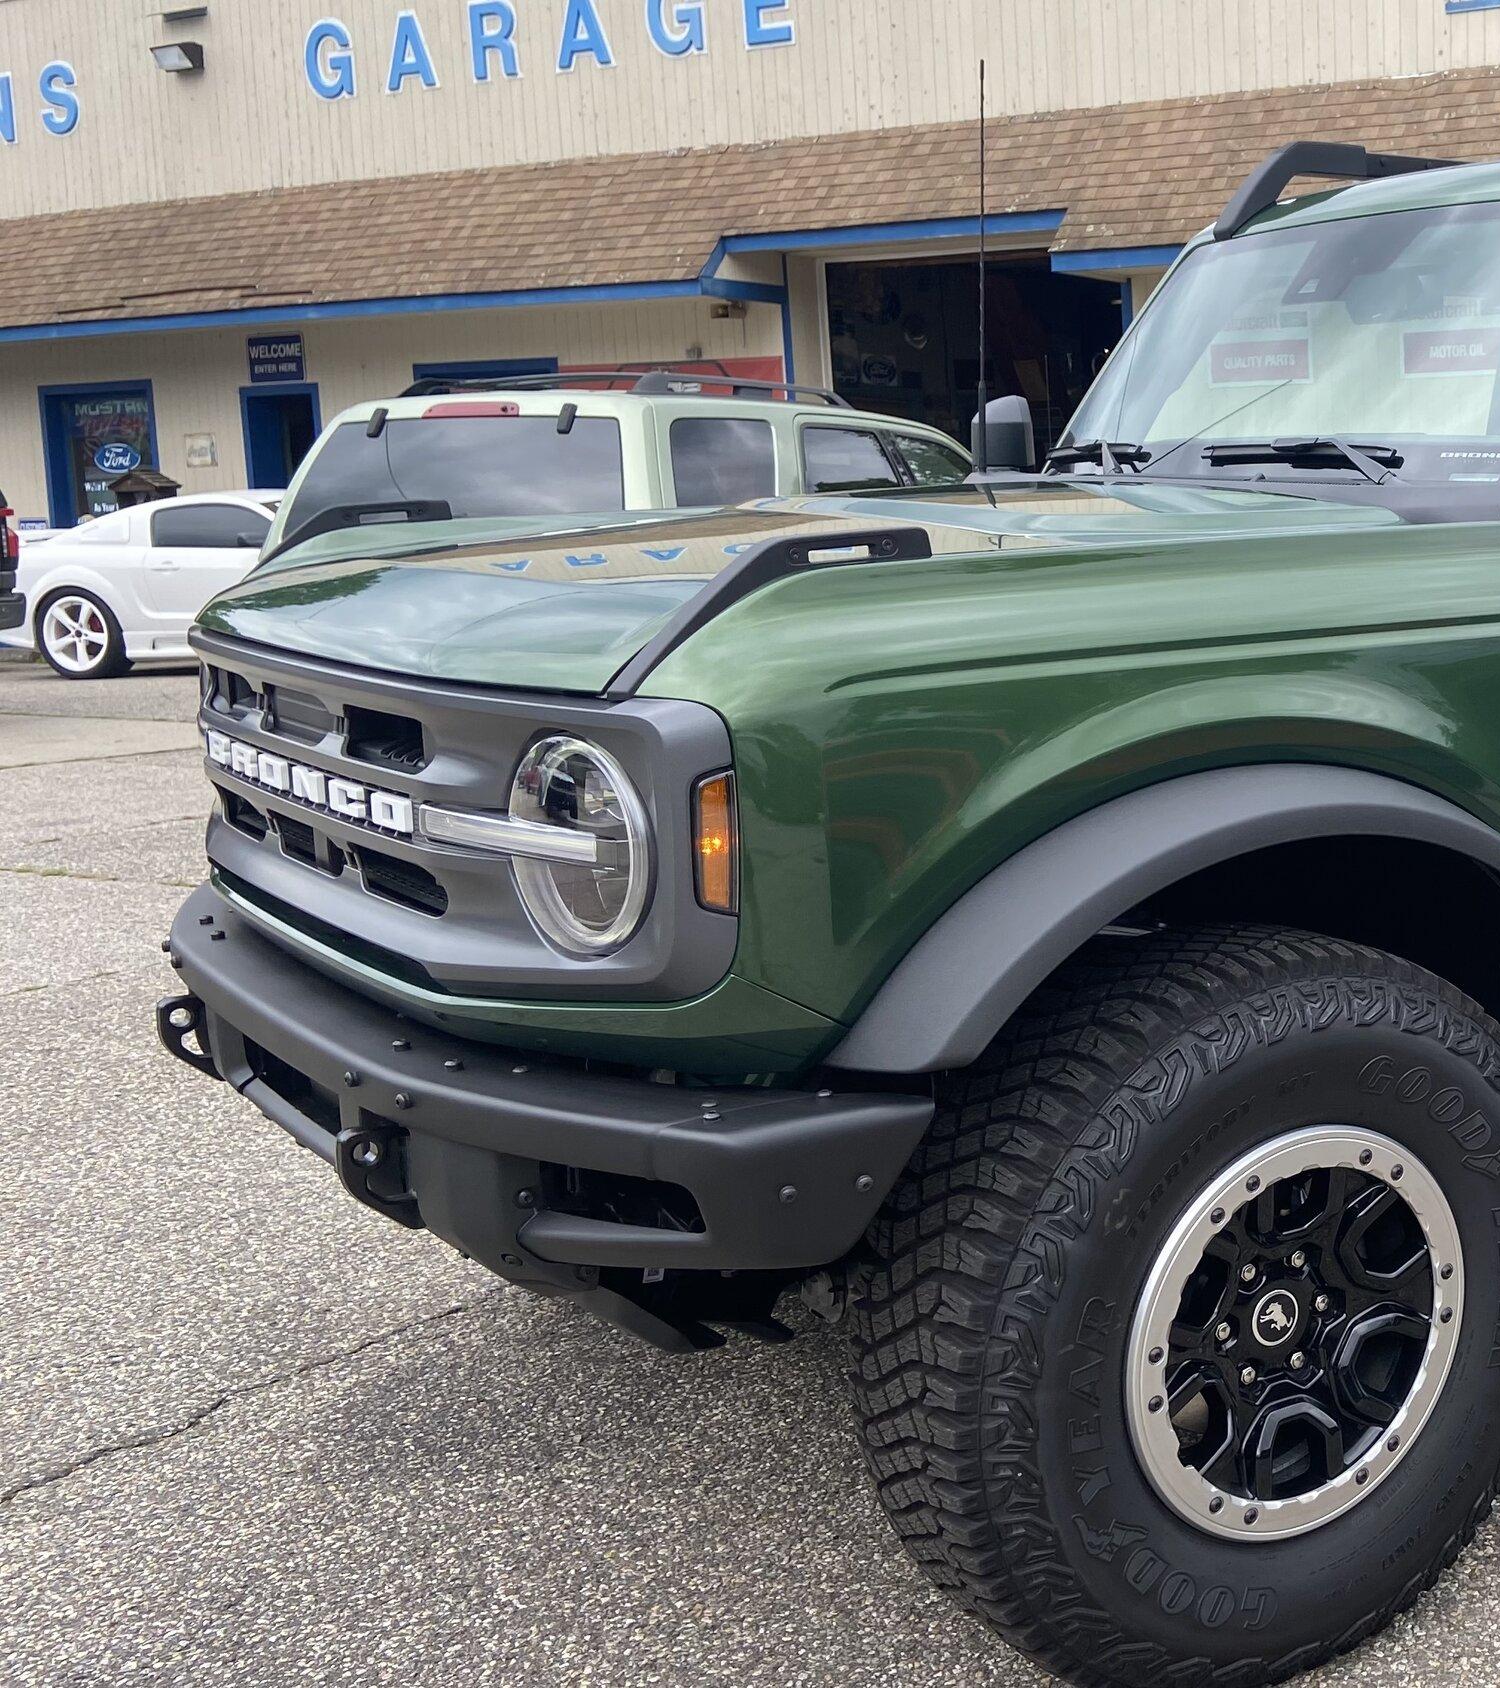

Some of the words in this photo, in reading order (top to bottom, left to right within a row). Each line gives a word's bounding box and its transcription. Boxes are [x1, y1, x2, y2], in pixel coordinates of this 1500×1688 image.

[303, 0, 797, 98] GARAGE
[249, 342, 302, 359] WELCOME
[1428, 344, 1467, 359] MOTOR
[1469, 343, 1487, 357] OIL
[254, 363, 278, 374] ENTER
[278, 361, 298, 373] HERE
[1223, 355, 1263, 369] QUALITY
[1264, 354, 1296, 367] PARTS
[104, 447, 131, 468] Ford
[208, 729, 414, 833] BRONCO
